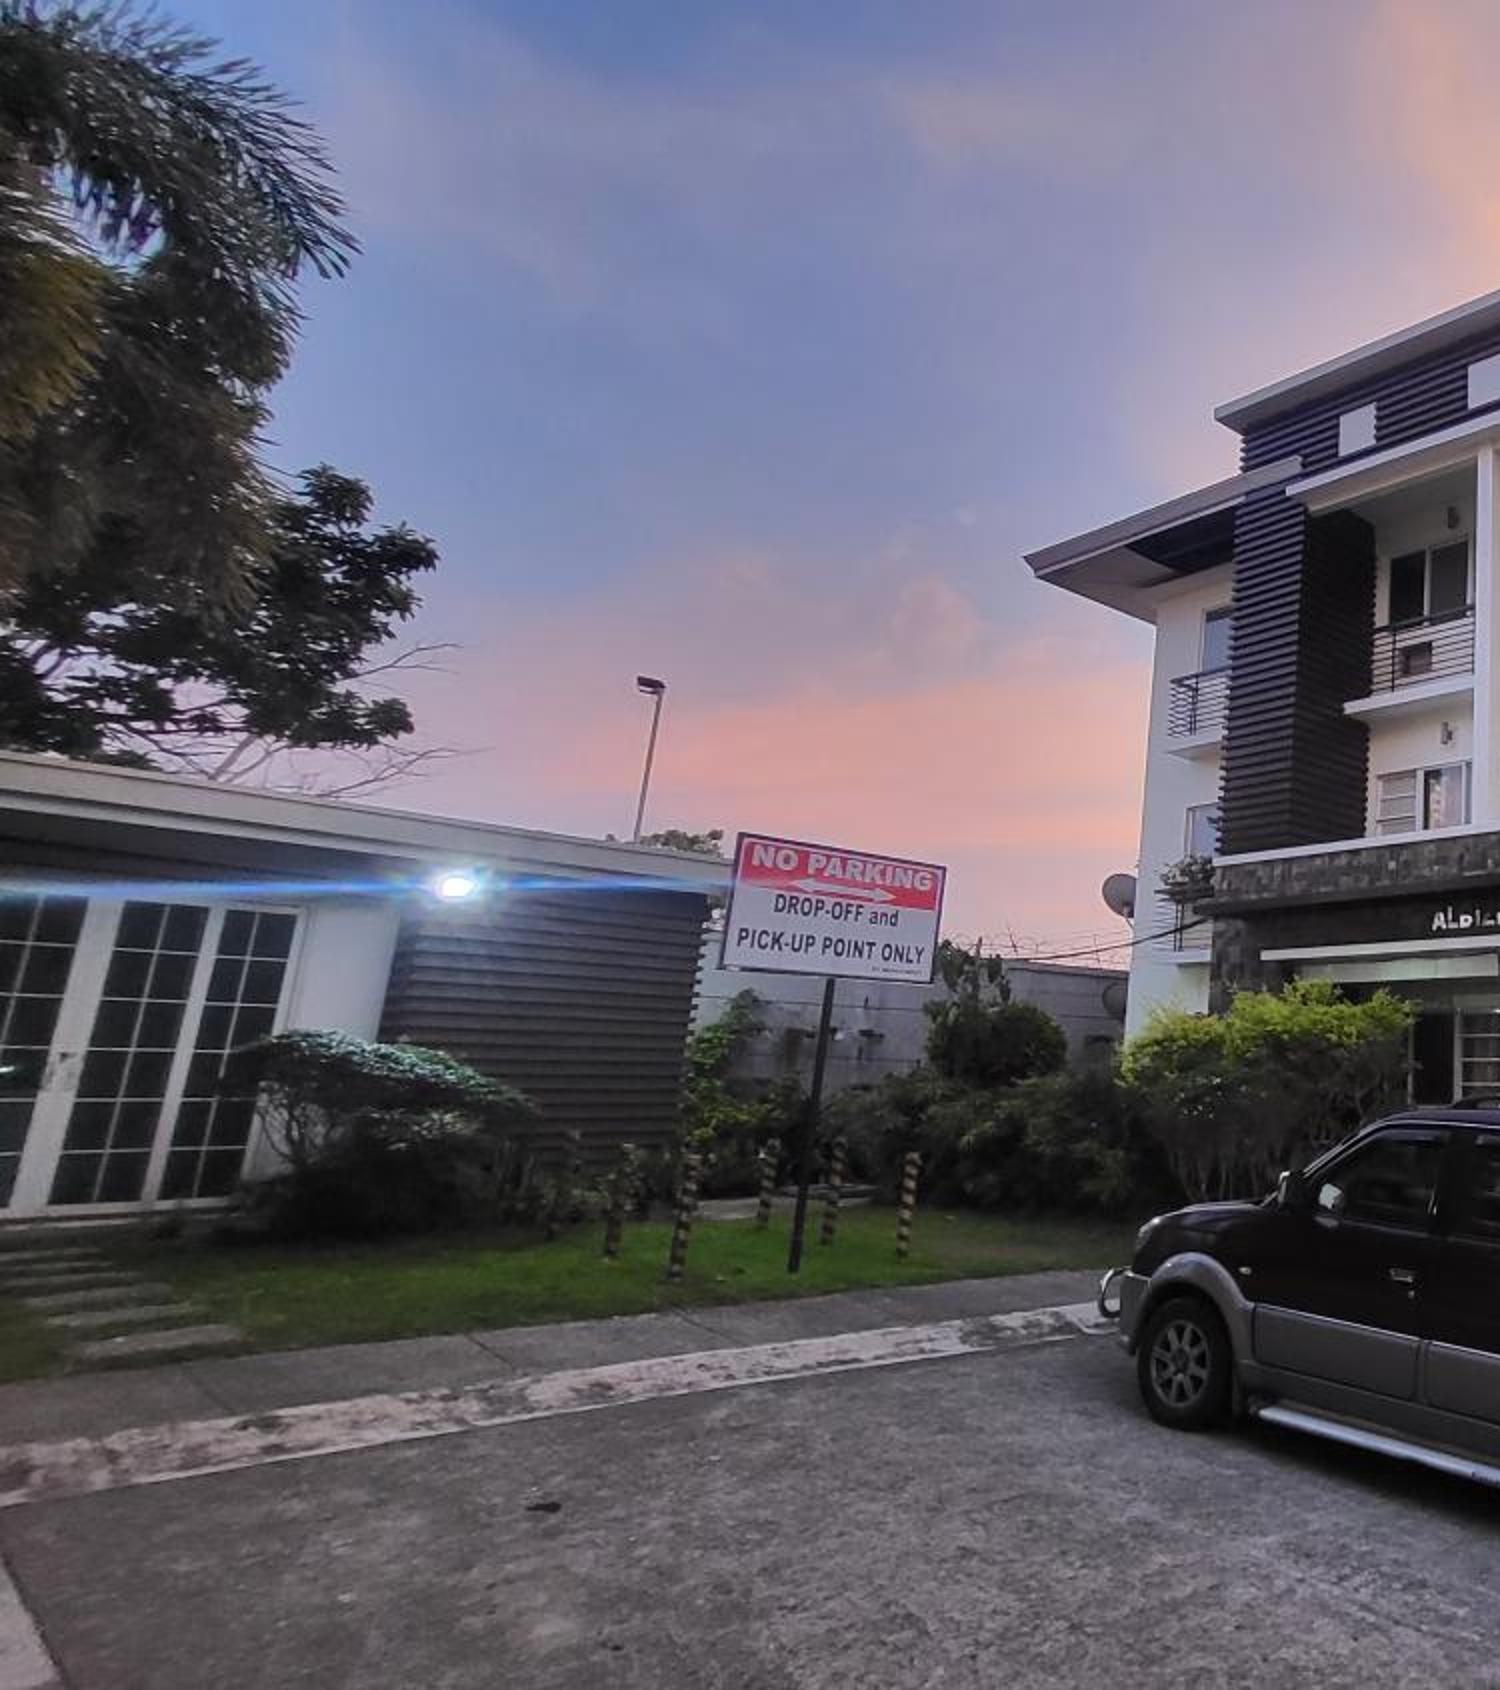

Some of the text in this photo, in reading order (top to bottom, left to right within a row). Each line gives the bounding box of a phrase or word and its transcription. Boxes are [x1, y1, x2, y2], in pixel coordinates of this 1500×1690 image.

[752, 845, 933, 891] NO PARKING
[774, 894, 899, 927] DROP-OFF and
[737, 928, 925, 964] PICK-UP POINT ONLY
